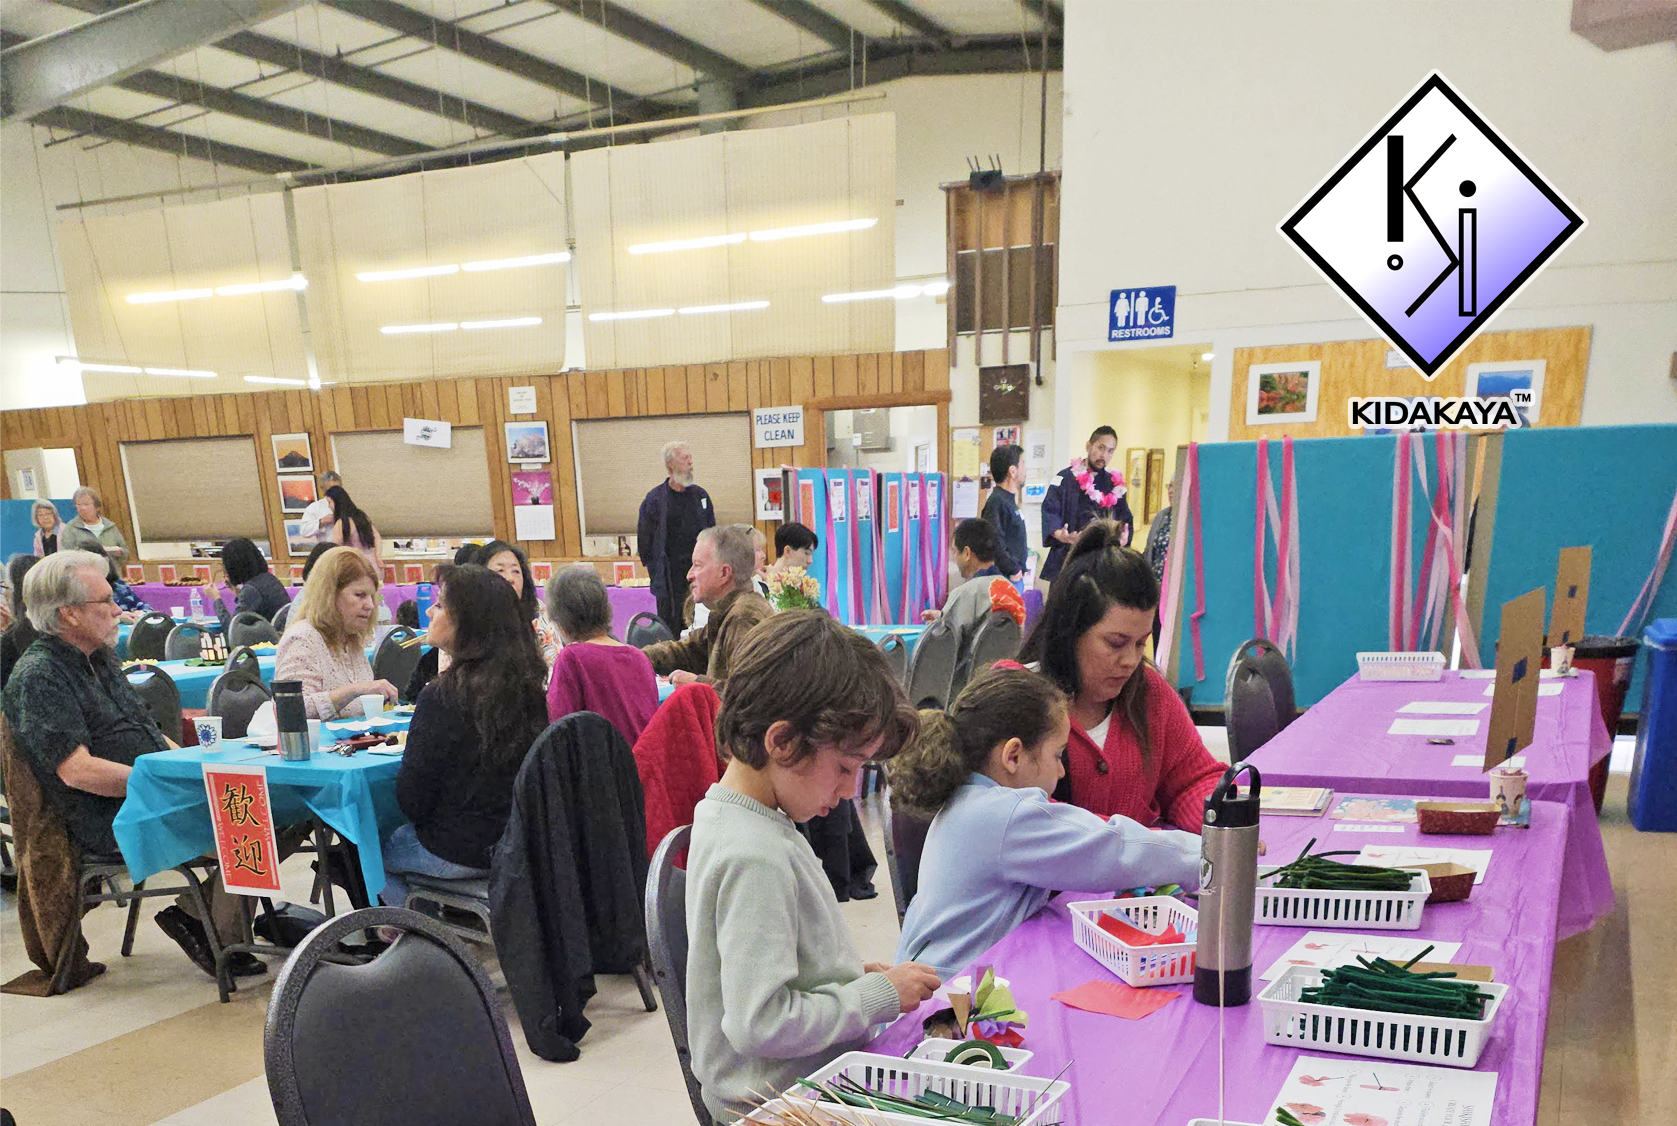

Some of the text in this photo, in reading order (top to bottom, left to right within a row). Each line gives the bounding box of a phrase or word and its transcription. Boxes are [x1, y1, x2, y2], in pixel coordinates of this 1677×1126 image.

[1111, 326, 1171, 339] RESTROOMS
[756, 411, 801, 425] PLEASE KEEP
[764, 428, 795, 441] CLEAN
[221, 783, 267, 876] 歓迎
